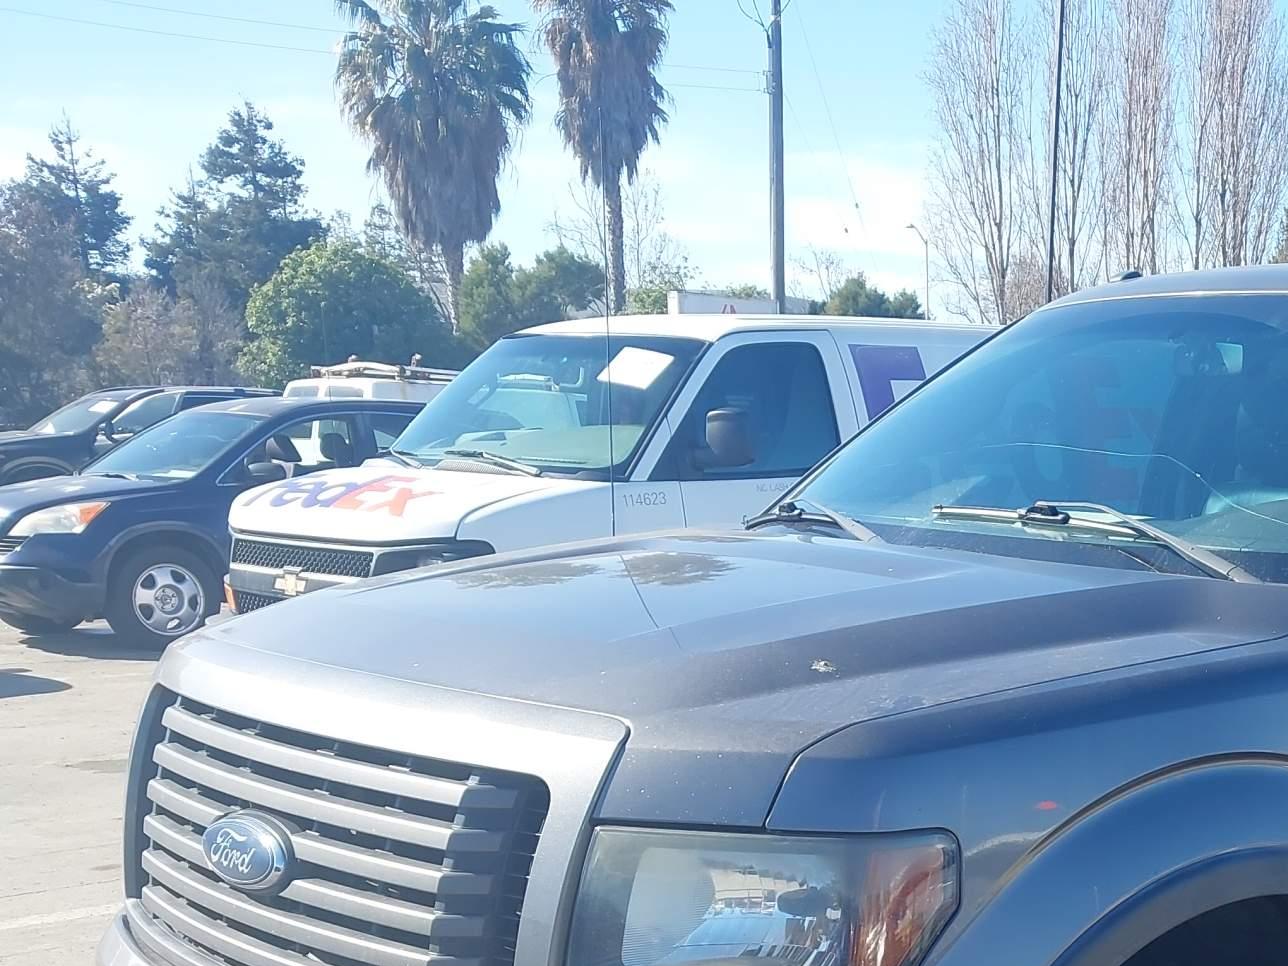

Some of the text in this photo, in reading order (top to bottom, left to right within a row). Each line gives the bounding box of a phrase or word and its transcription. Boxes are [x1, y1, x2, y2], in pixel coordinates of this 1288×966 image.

[241, 474, 445, 517] FedEx
[622, 491, 667, 507] 114623
[210, 828, 256, 874] Ford
